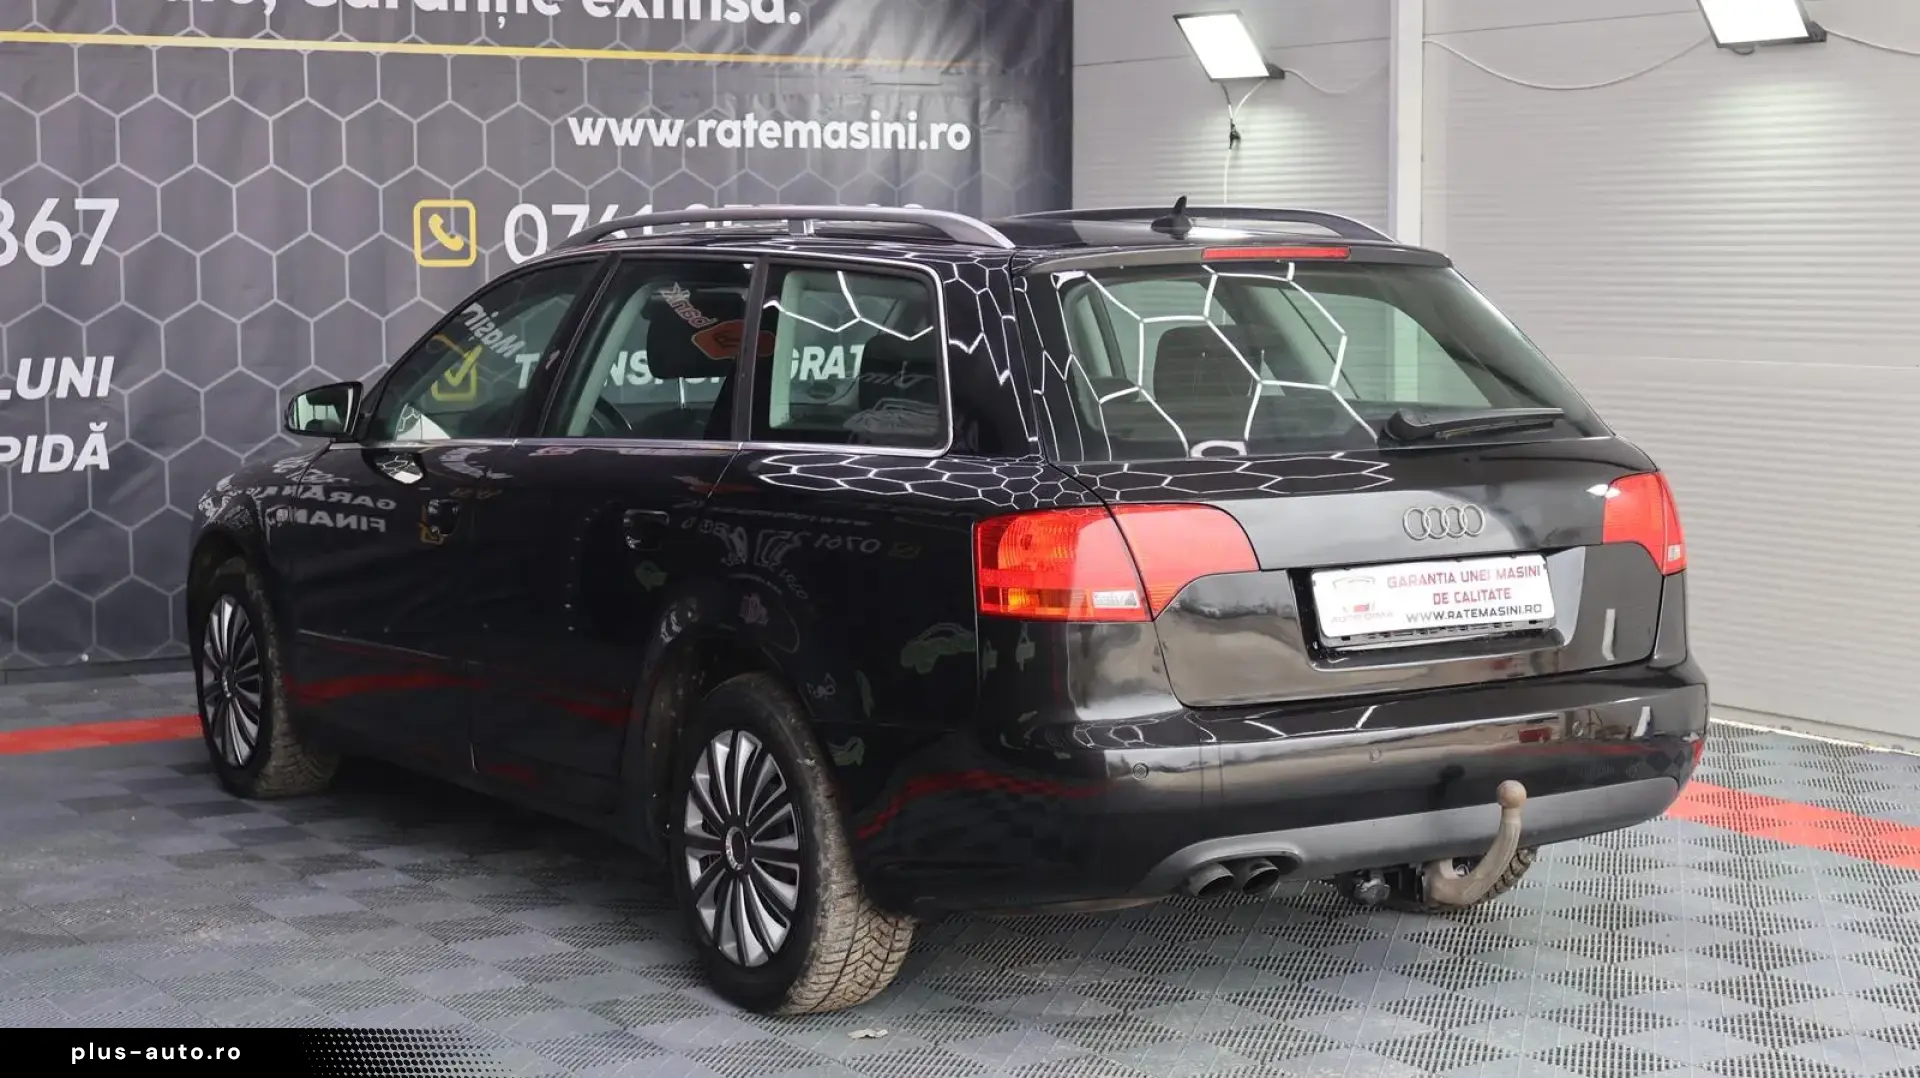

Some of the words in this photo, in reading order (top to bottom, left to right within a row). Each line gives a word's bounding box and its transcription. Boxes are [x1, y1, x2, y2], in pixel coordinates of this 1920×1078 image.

[567, 110, 972, 151] www.ratemasini.ro
[1387, 572, 1457, 589] GARANTIA
[1460, 569, 1491, 583] UNEI
[1496, 565, 1541, 581] MASINI
[1433, 592, 1449, 606] DE
[1454, 587, 1512, 604] CALITATE
[1406, 604, 1543, 623] WWW.RATEMASINI.RO
